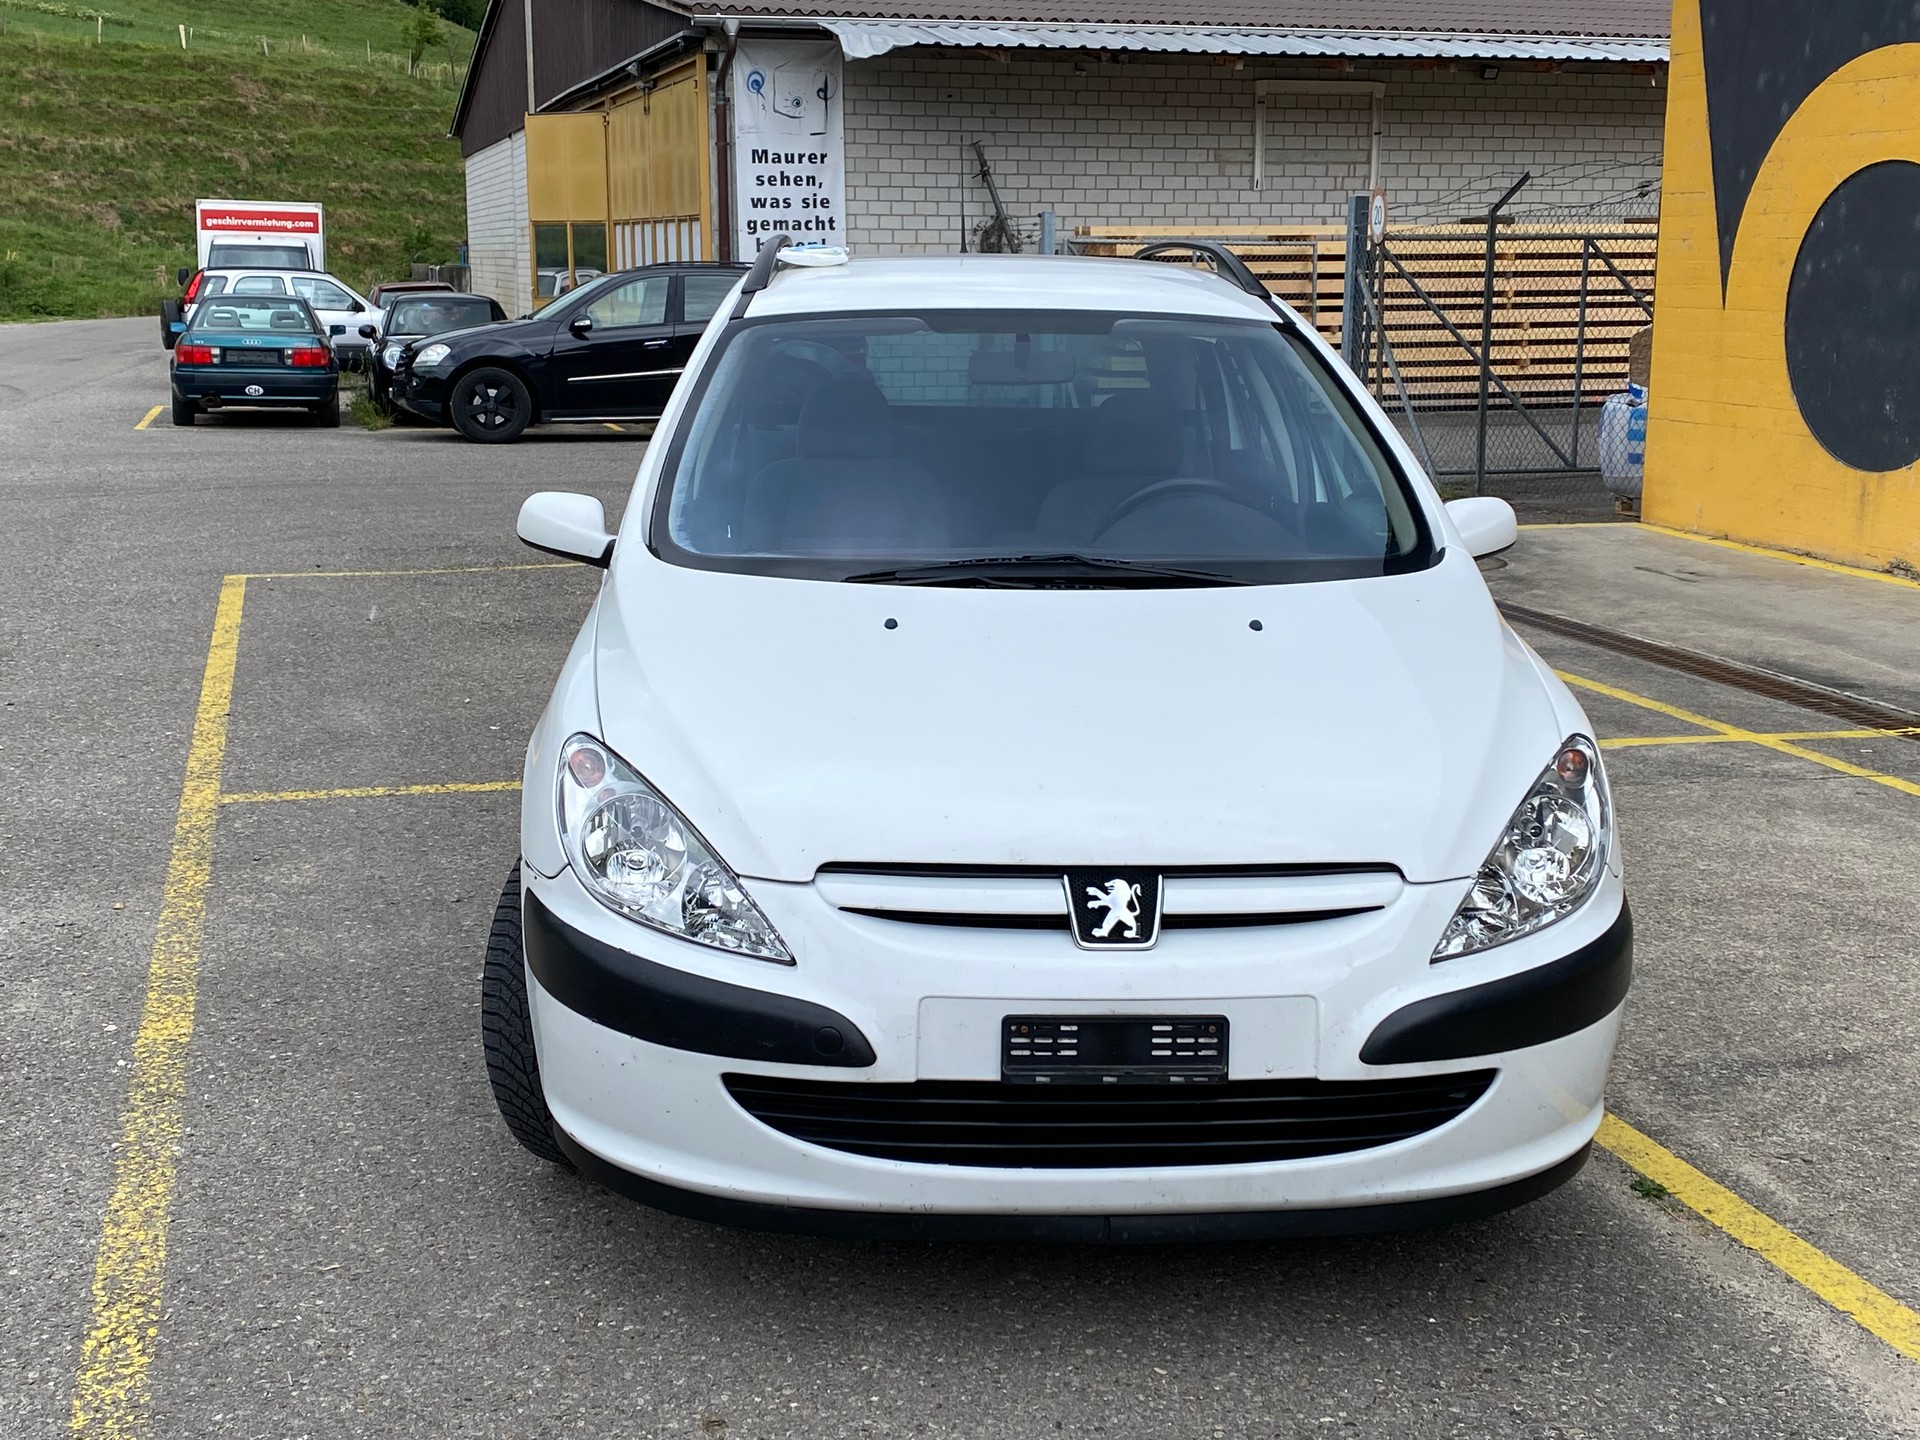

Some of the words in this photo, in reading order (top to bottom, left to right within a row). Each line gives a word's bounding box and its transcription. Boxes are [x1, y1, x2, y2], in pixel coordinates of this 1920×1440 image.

[751, 149, 828, 164] Maurer
[755, 171, 823, 189] sehen,
[750, 197, 792, 209] was
[801, 193, 830, 209] sie
[205, 215, 314, 229] geschirrvermietung.com
[1374, 205, 1383, 226] 20
[746, 215, 836, 235] gemacht
[247, 386, 261, 395] CH
